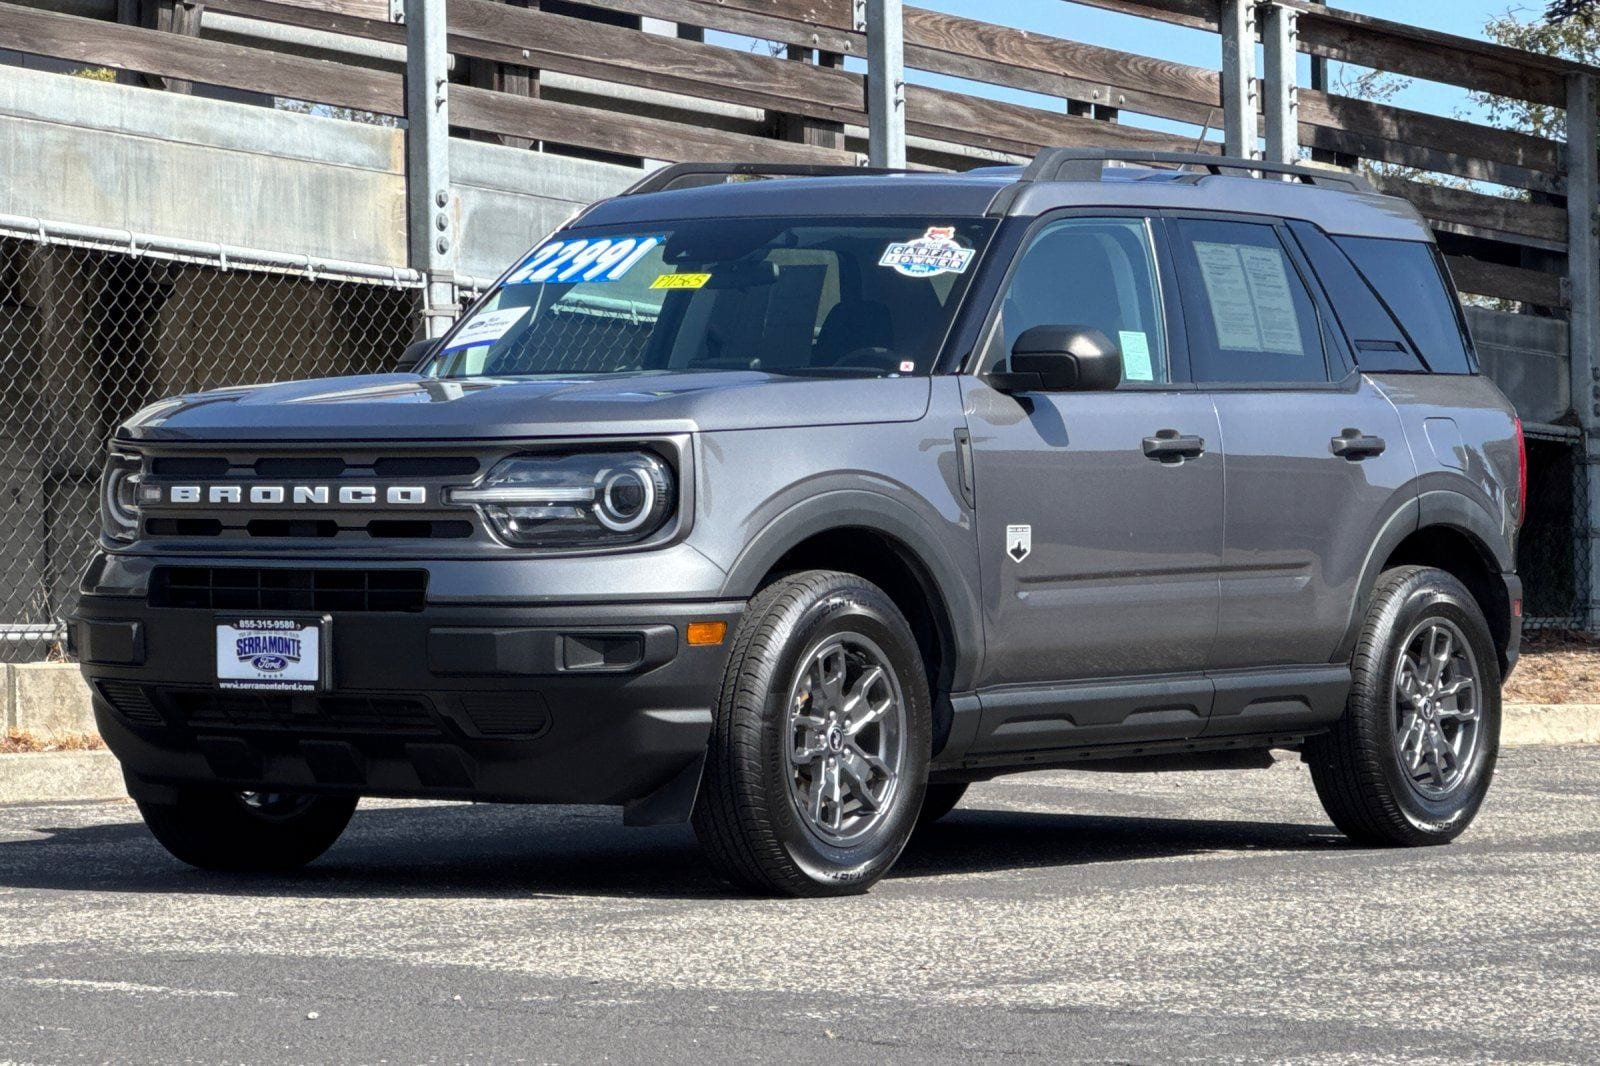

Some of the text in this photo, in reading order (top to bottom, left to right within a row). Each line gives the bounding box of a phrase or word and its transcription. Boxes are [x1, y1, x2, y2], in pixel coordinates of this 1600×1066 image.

[505, 237, 658, 284] 22991
[890, 245, 967, 261] CARFAX
[900, 255, 964, 269] OWNER
[170, 486, 427, 504] BRONCO
[239, 619, 295, 629] 855-315-9580
[236, 635, 302, 657] SERRAMONTE
[257, 656, 283, 669] Ford
[219, 682, 315, 691] www.serramonteford.com
